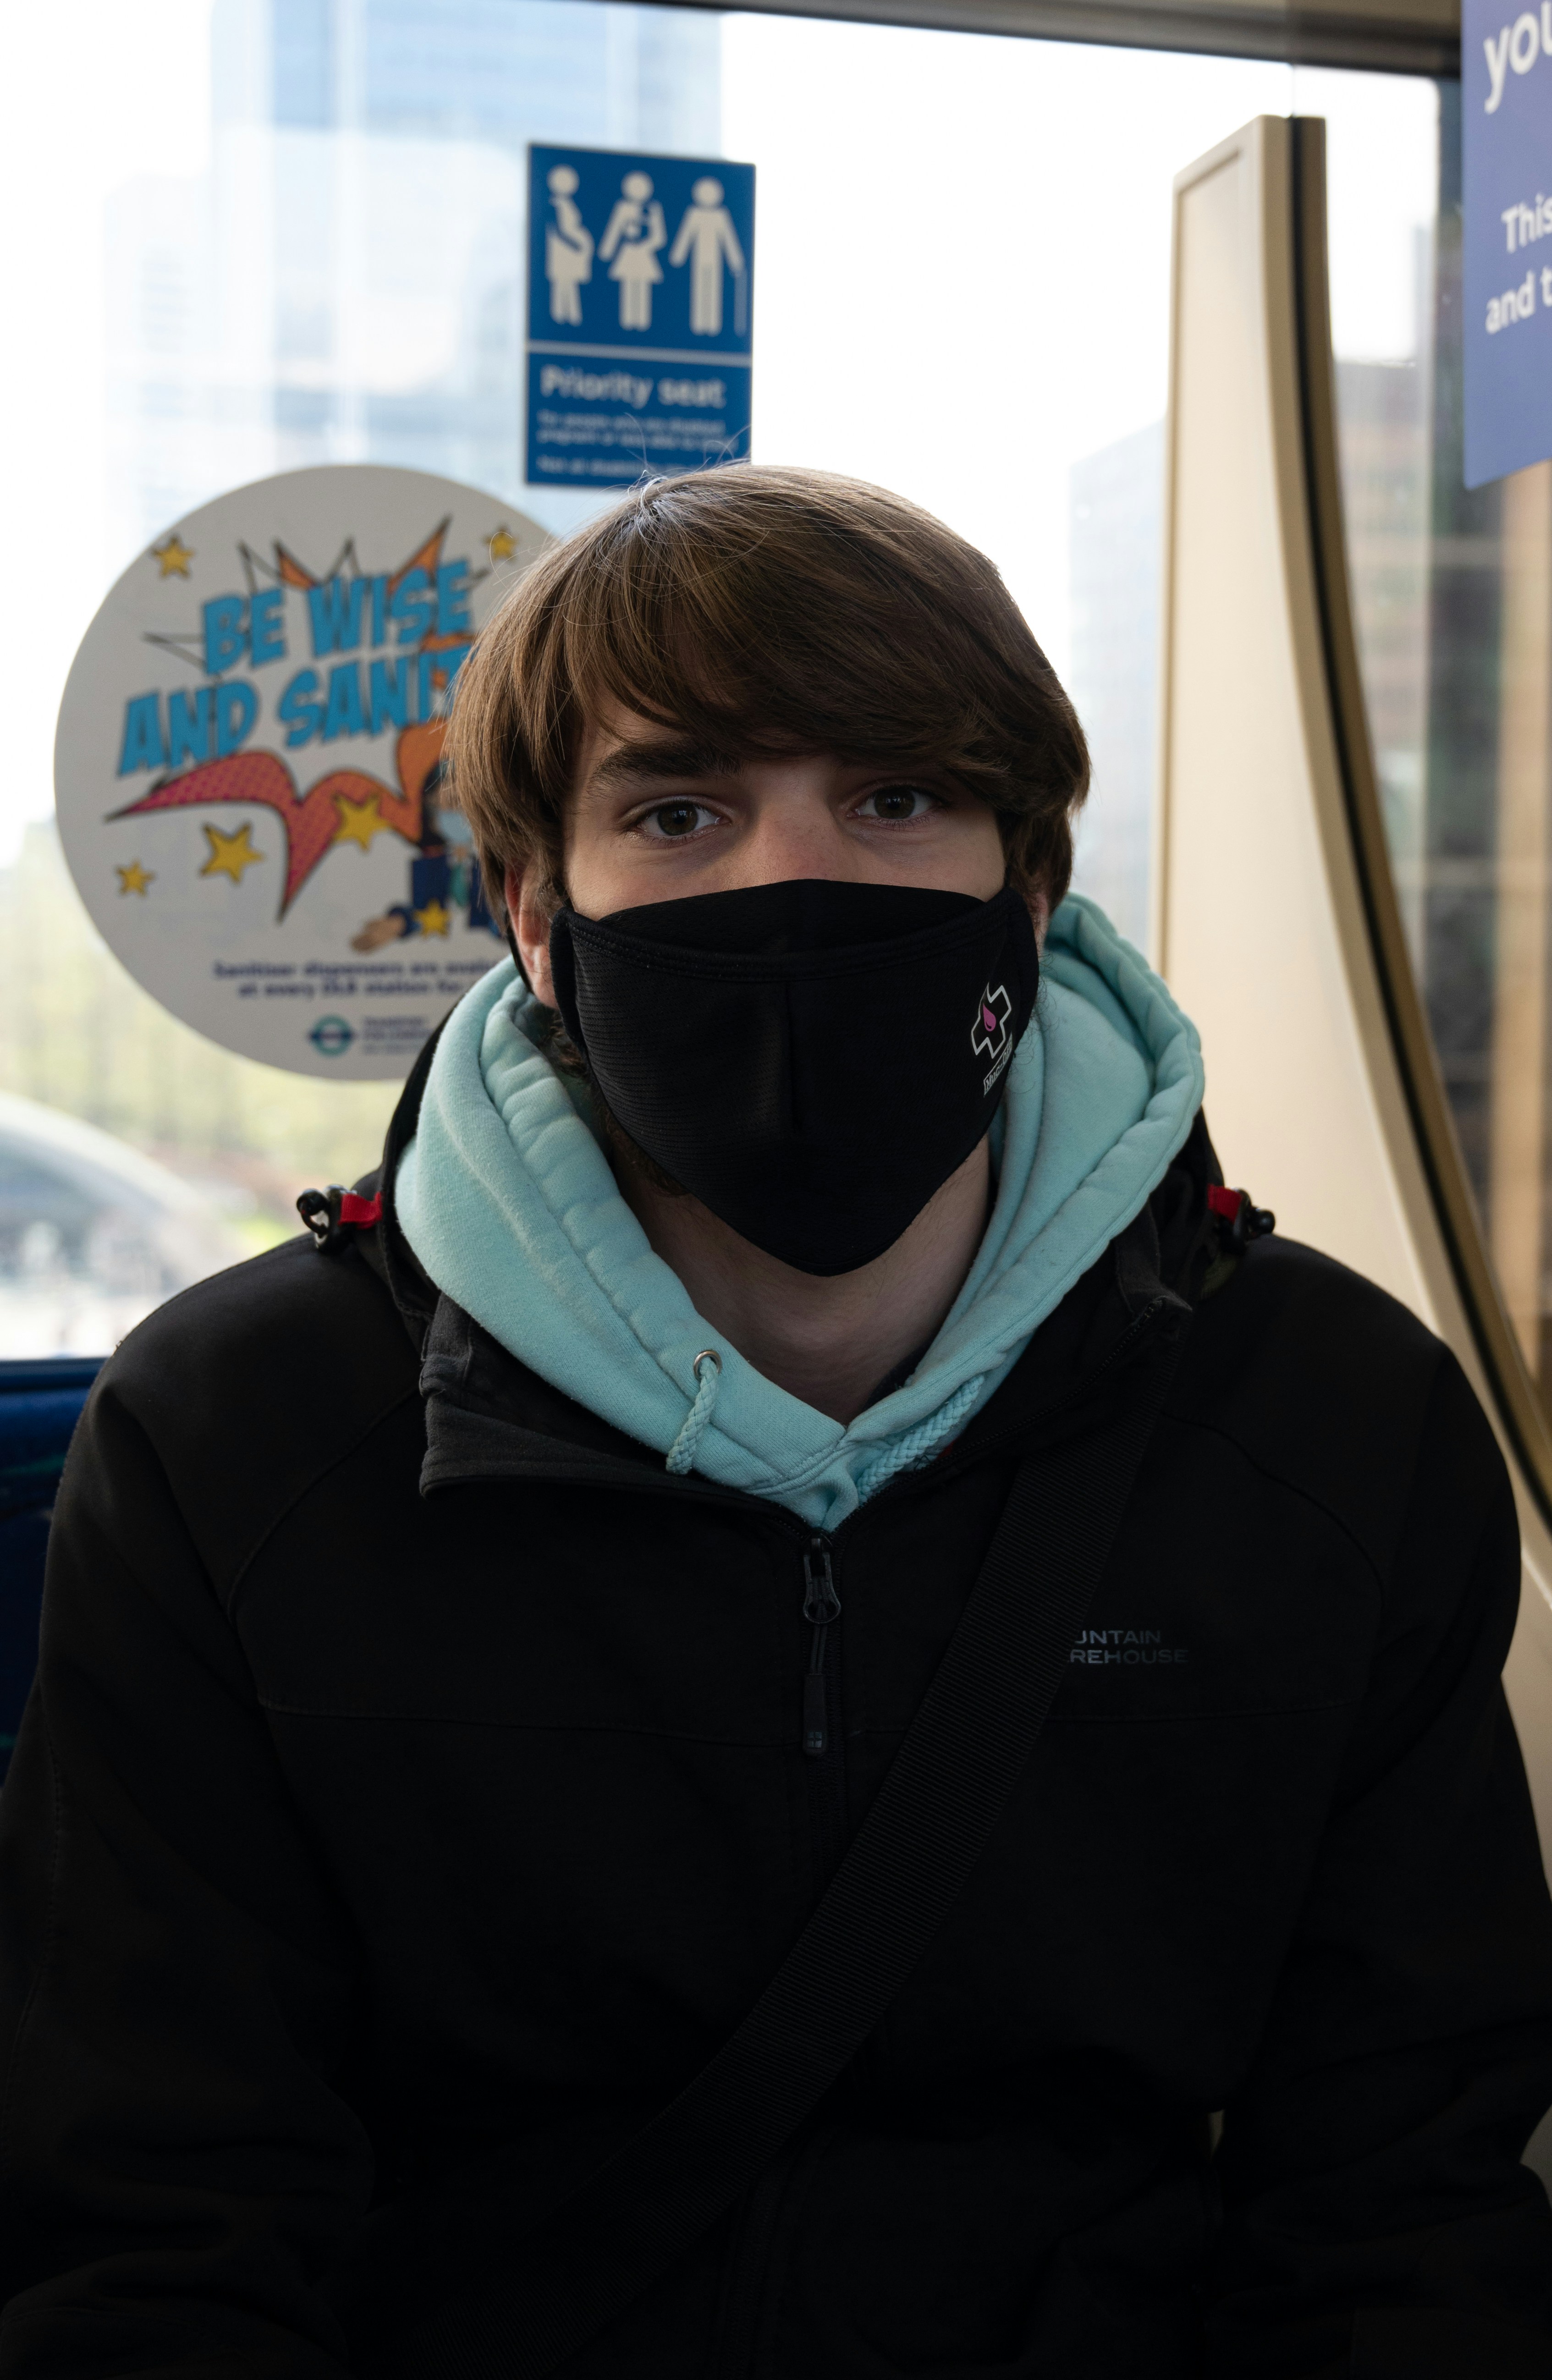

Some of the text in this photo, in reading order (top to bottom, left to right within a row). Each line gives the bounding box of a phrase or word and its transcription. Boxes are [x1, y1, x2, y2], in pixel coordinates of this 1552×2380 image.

[1485, 269, 1535, 335] and
[540, 364, 726, 409] Priority seat
[203, 558, 473, 677] BE WISE
[117, 680, 258, 777] AND
